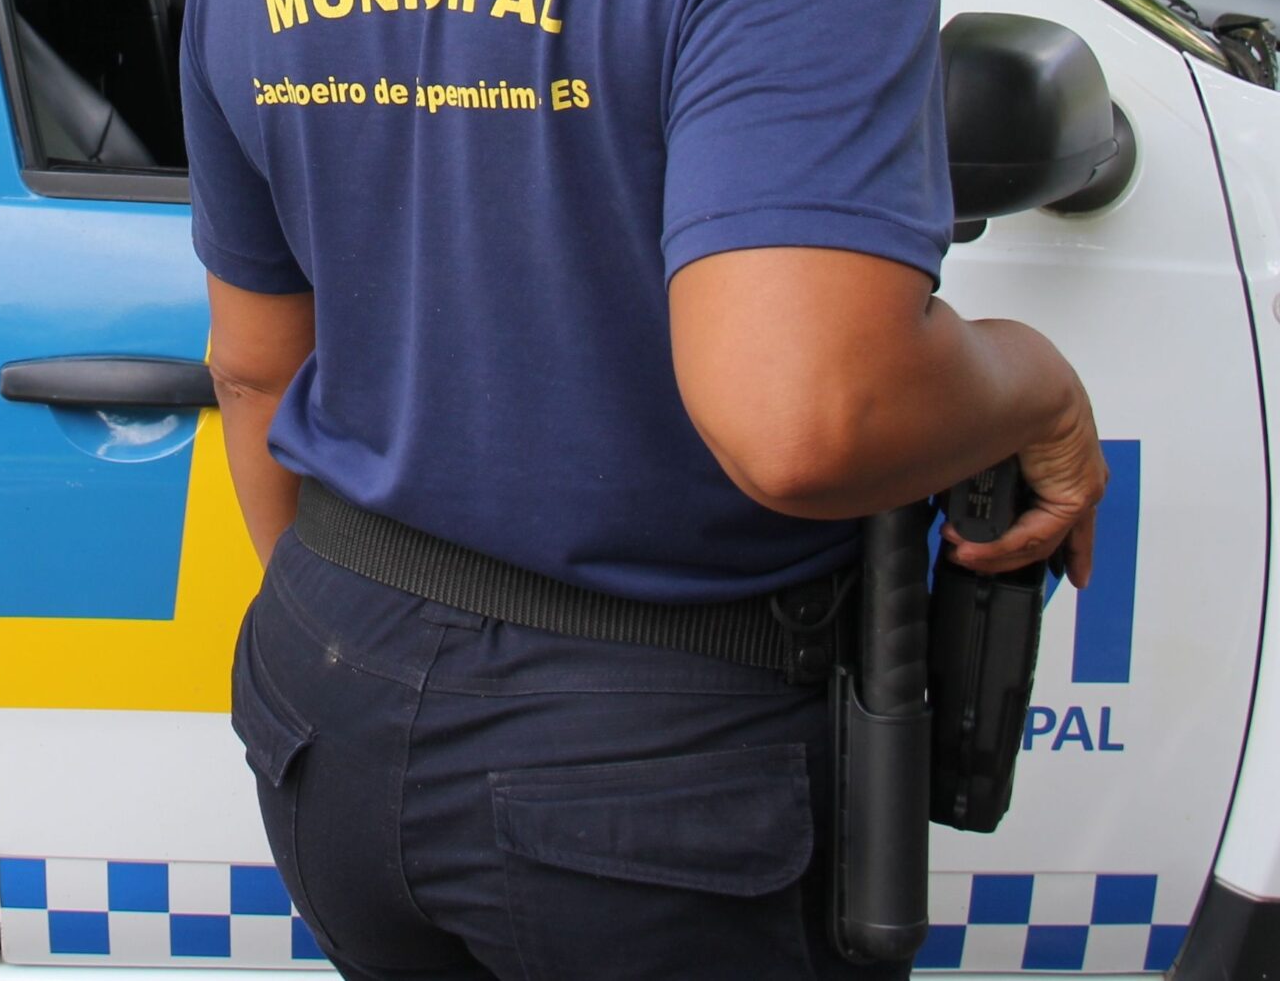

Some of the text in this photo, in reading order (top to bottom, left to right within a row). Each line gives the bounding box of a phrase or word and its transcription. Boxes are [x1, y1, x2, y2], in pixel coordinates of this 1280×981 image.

[253, 75, 592, 115] Cachoeiro de apemirim ES
[1022, 706, 1125, 753] PAL
